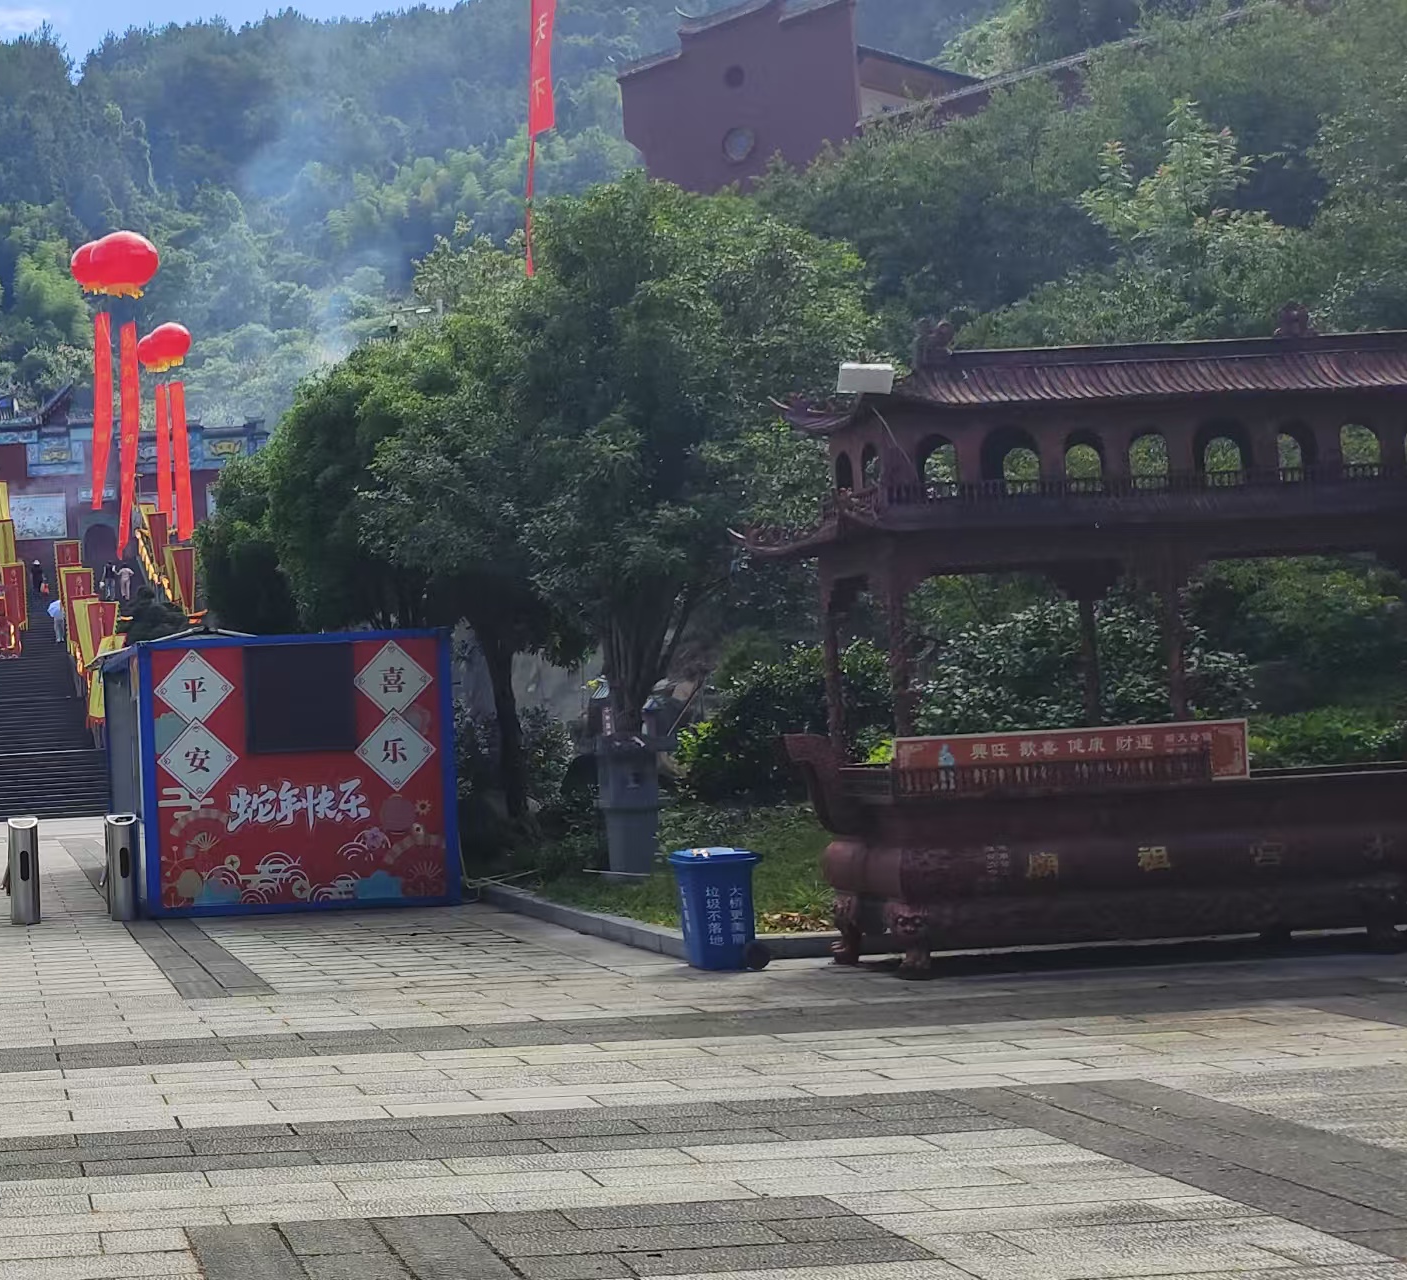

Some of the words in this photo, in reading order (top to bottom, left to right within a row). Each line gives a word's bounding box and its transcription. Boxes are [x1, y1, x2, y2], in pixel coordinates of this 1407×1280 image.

[181, 675, 211, 775] 平安
[378, 666, 409, 765] 喜乐
[1067, 737, 1106, 754] 健康
[226, 778, 372, 832] 蛇年快乐
[705, 886, 725, 946] 垃圾不落地
